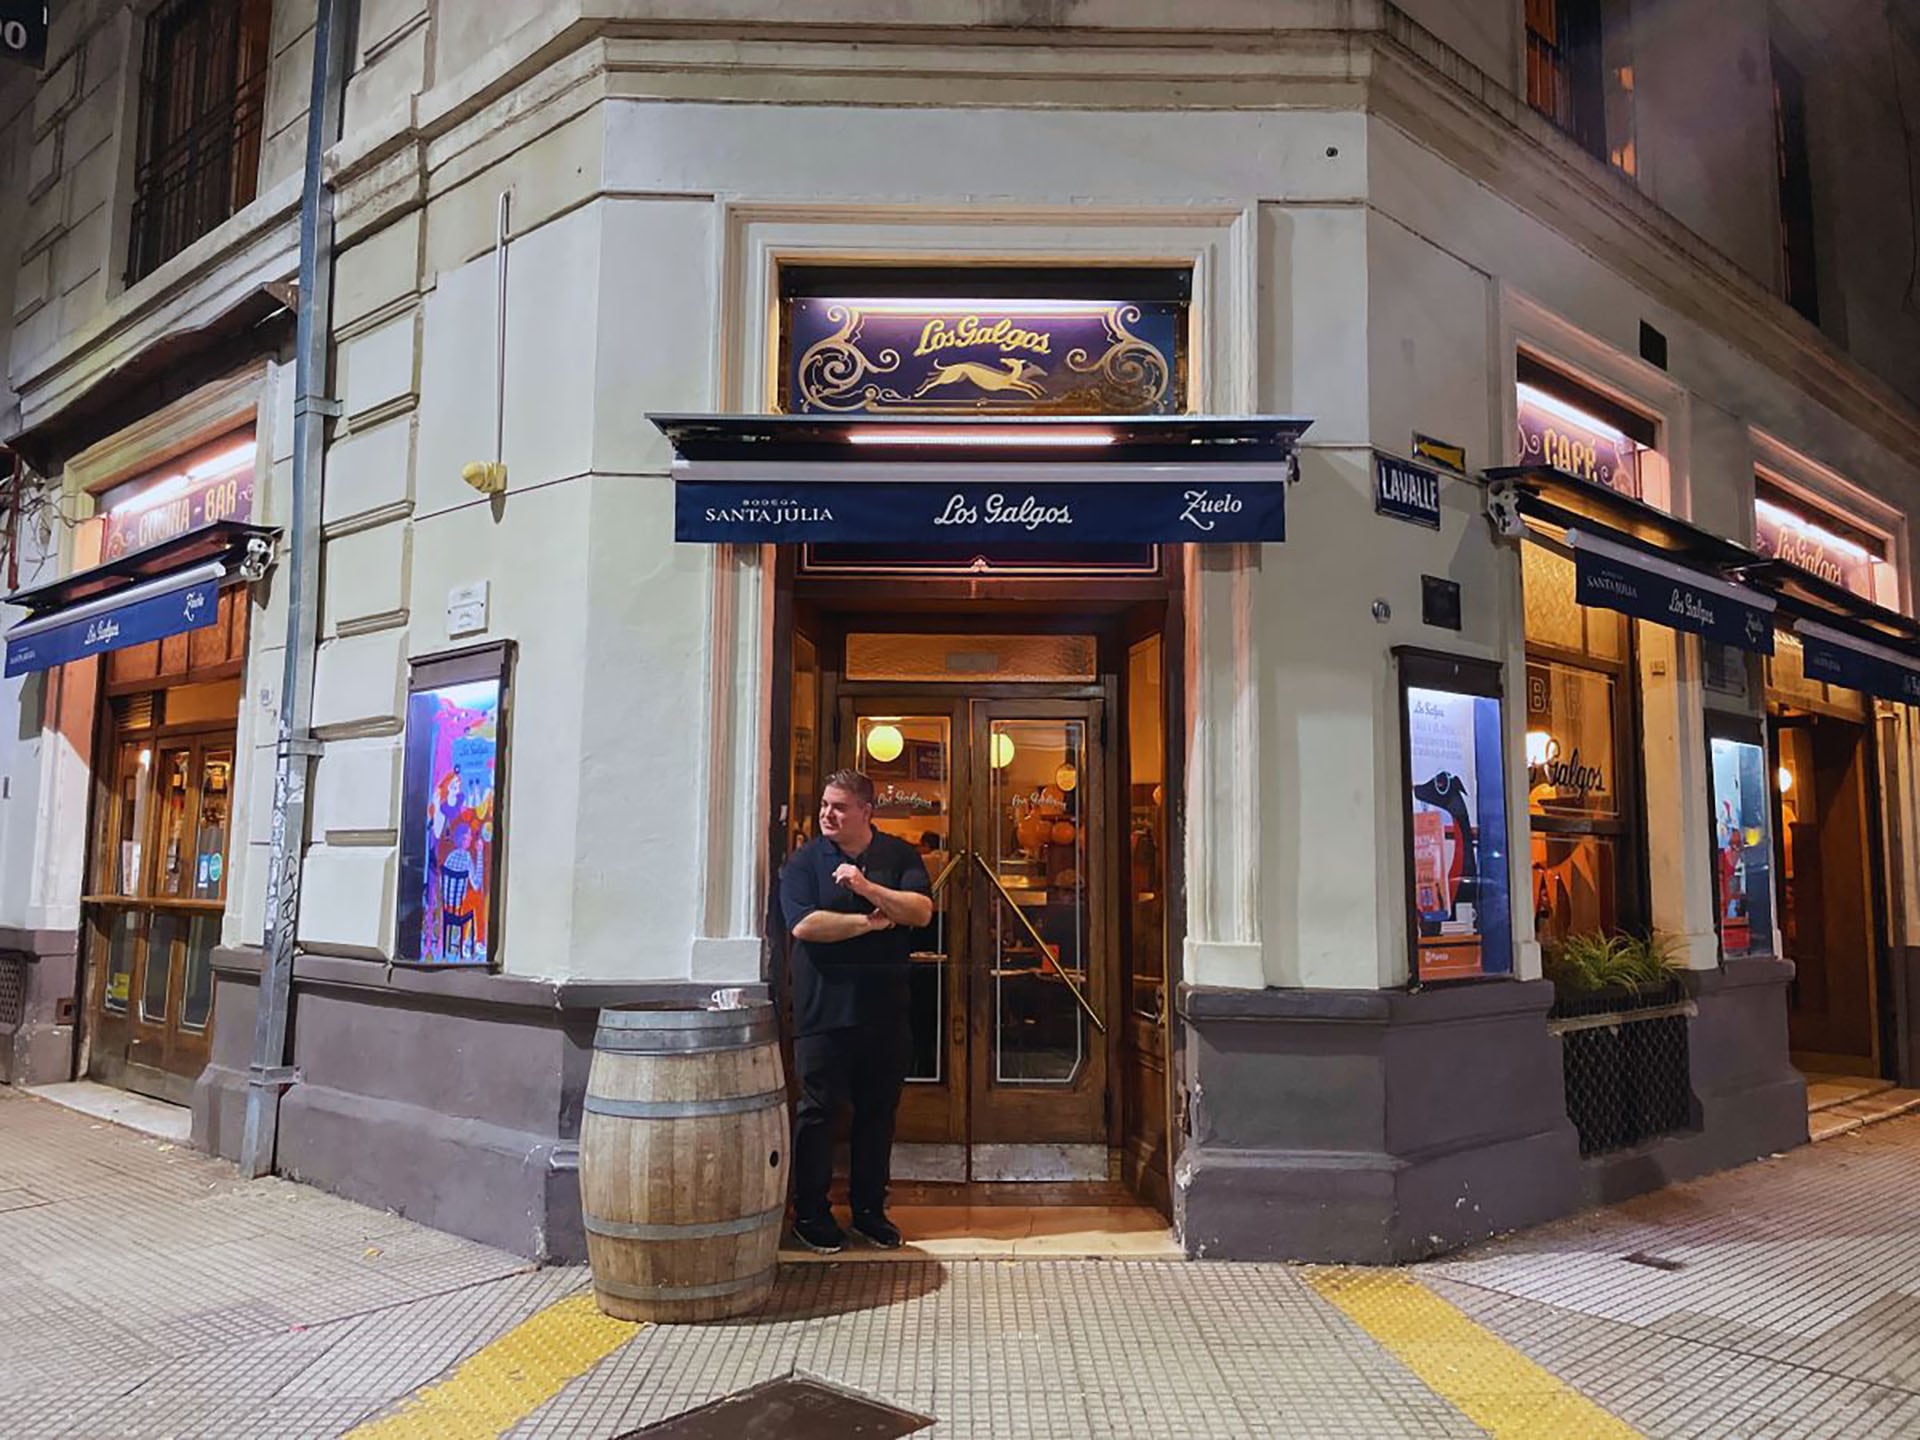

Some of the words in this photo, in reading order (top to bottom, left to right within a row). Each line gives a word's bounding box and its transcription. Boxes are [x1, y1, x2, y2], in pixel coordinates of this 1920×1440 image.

[914, 319, 955, 357] Los
[955, 315, 1051, 354] Galgos
[205, 479, 237, 522] BAR
[1381, 466, 1438, 512] LAVALLE
[705, 508, 771, 522] SANTA
[773, 508, 833, 524] JULIA
[934, 494, 978, 524] Los
[984, 493, 1073, 530] Galgos
[1179, 490, 1242, 531] Zuelo
[1668, 588, 1685, 615] Los
[1544, 738, 1606, 801] Galgos
